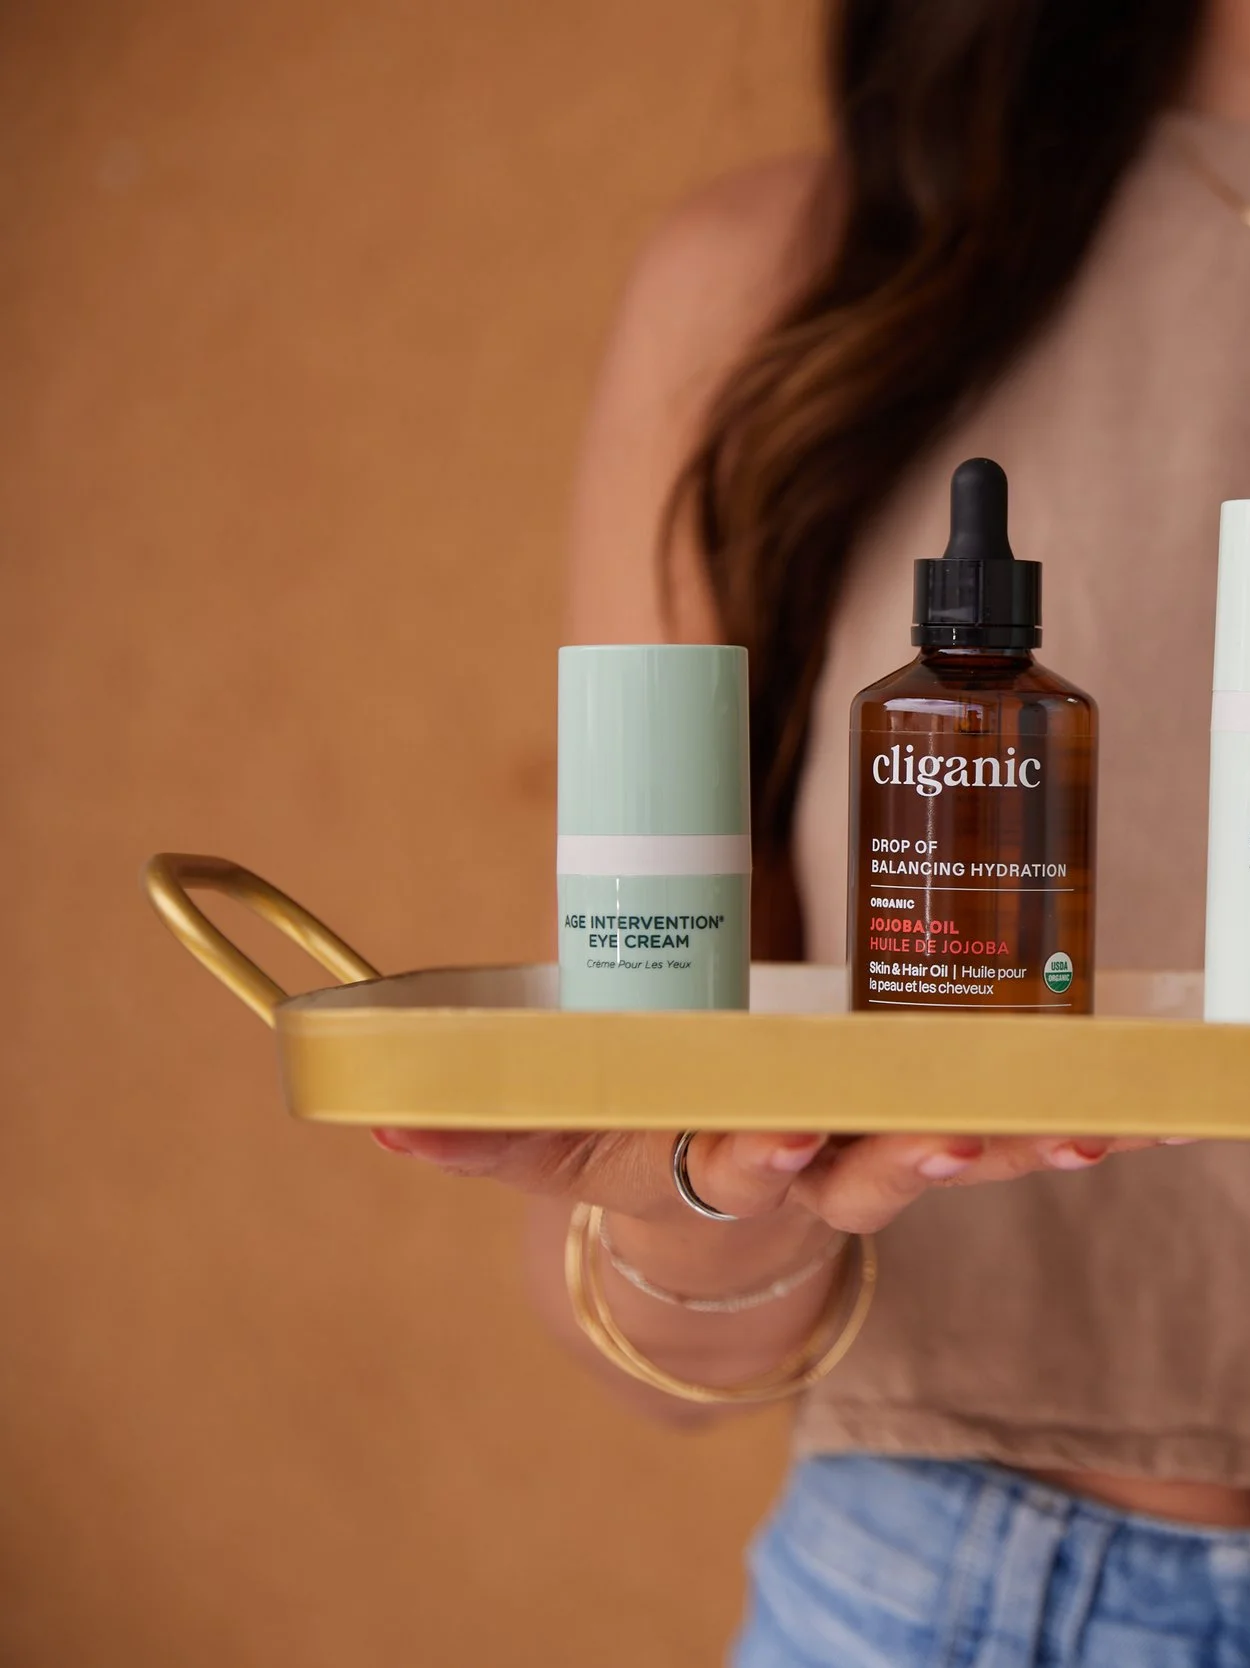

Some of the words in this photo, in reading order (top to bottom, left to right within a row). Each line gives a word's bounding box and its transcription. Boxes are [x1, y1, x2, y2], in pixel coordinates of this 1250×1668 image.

[872, 744, 1041, 797] cliganic
[872, 838, 910, 853] DROP
[915, 840, 938, 854] OF
[871, 859, 965, 876] BALANCING
[970, 863, 1067, 878] HYDRATION
[870, 897, 915, 909] ORGANIC
[565, 915, 586, 928] AGE
[870, 918, 924, 934] JOJOBA
[930, 920, 959, 935] OIL
[589, 934, 618, 948] EYE
[624, 935, 689, 948] CREAM
[870, 937, 910, 952] HUILE
[915, 939, 936, 954] DE
[941, 940, 1010, 955] JOJOBA
[618, 960, 642, 969] Pour
[645, 960, 663, 969] Les
[667, 960, 691, 969] Yeux
[869, 961, 892, 975] Skin
[892, 963, 900, 975] &
[902, 963, 928, 977] Hair
[930, 964, 948, 978] Oil
[962, 965, 996, 978] Huile
[998, 966, 1027, 981] pour
[1051, 961, 1068, 971] USDA
[869, 977, 877, 990] la
[878, 980, 903, 993] peau
[905, 981, 917, 993] et
[918, 981, 936, 993] les
[937, 981, 994, 995] cheveux
